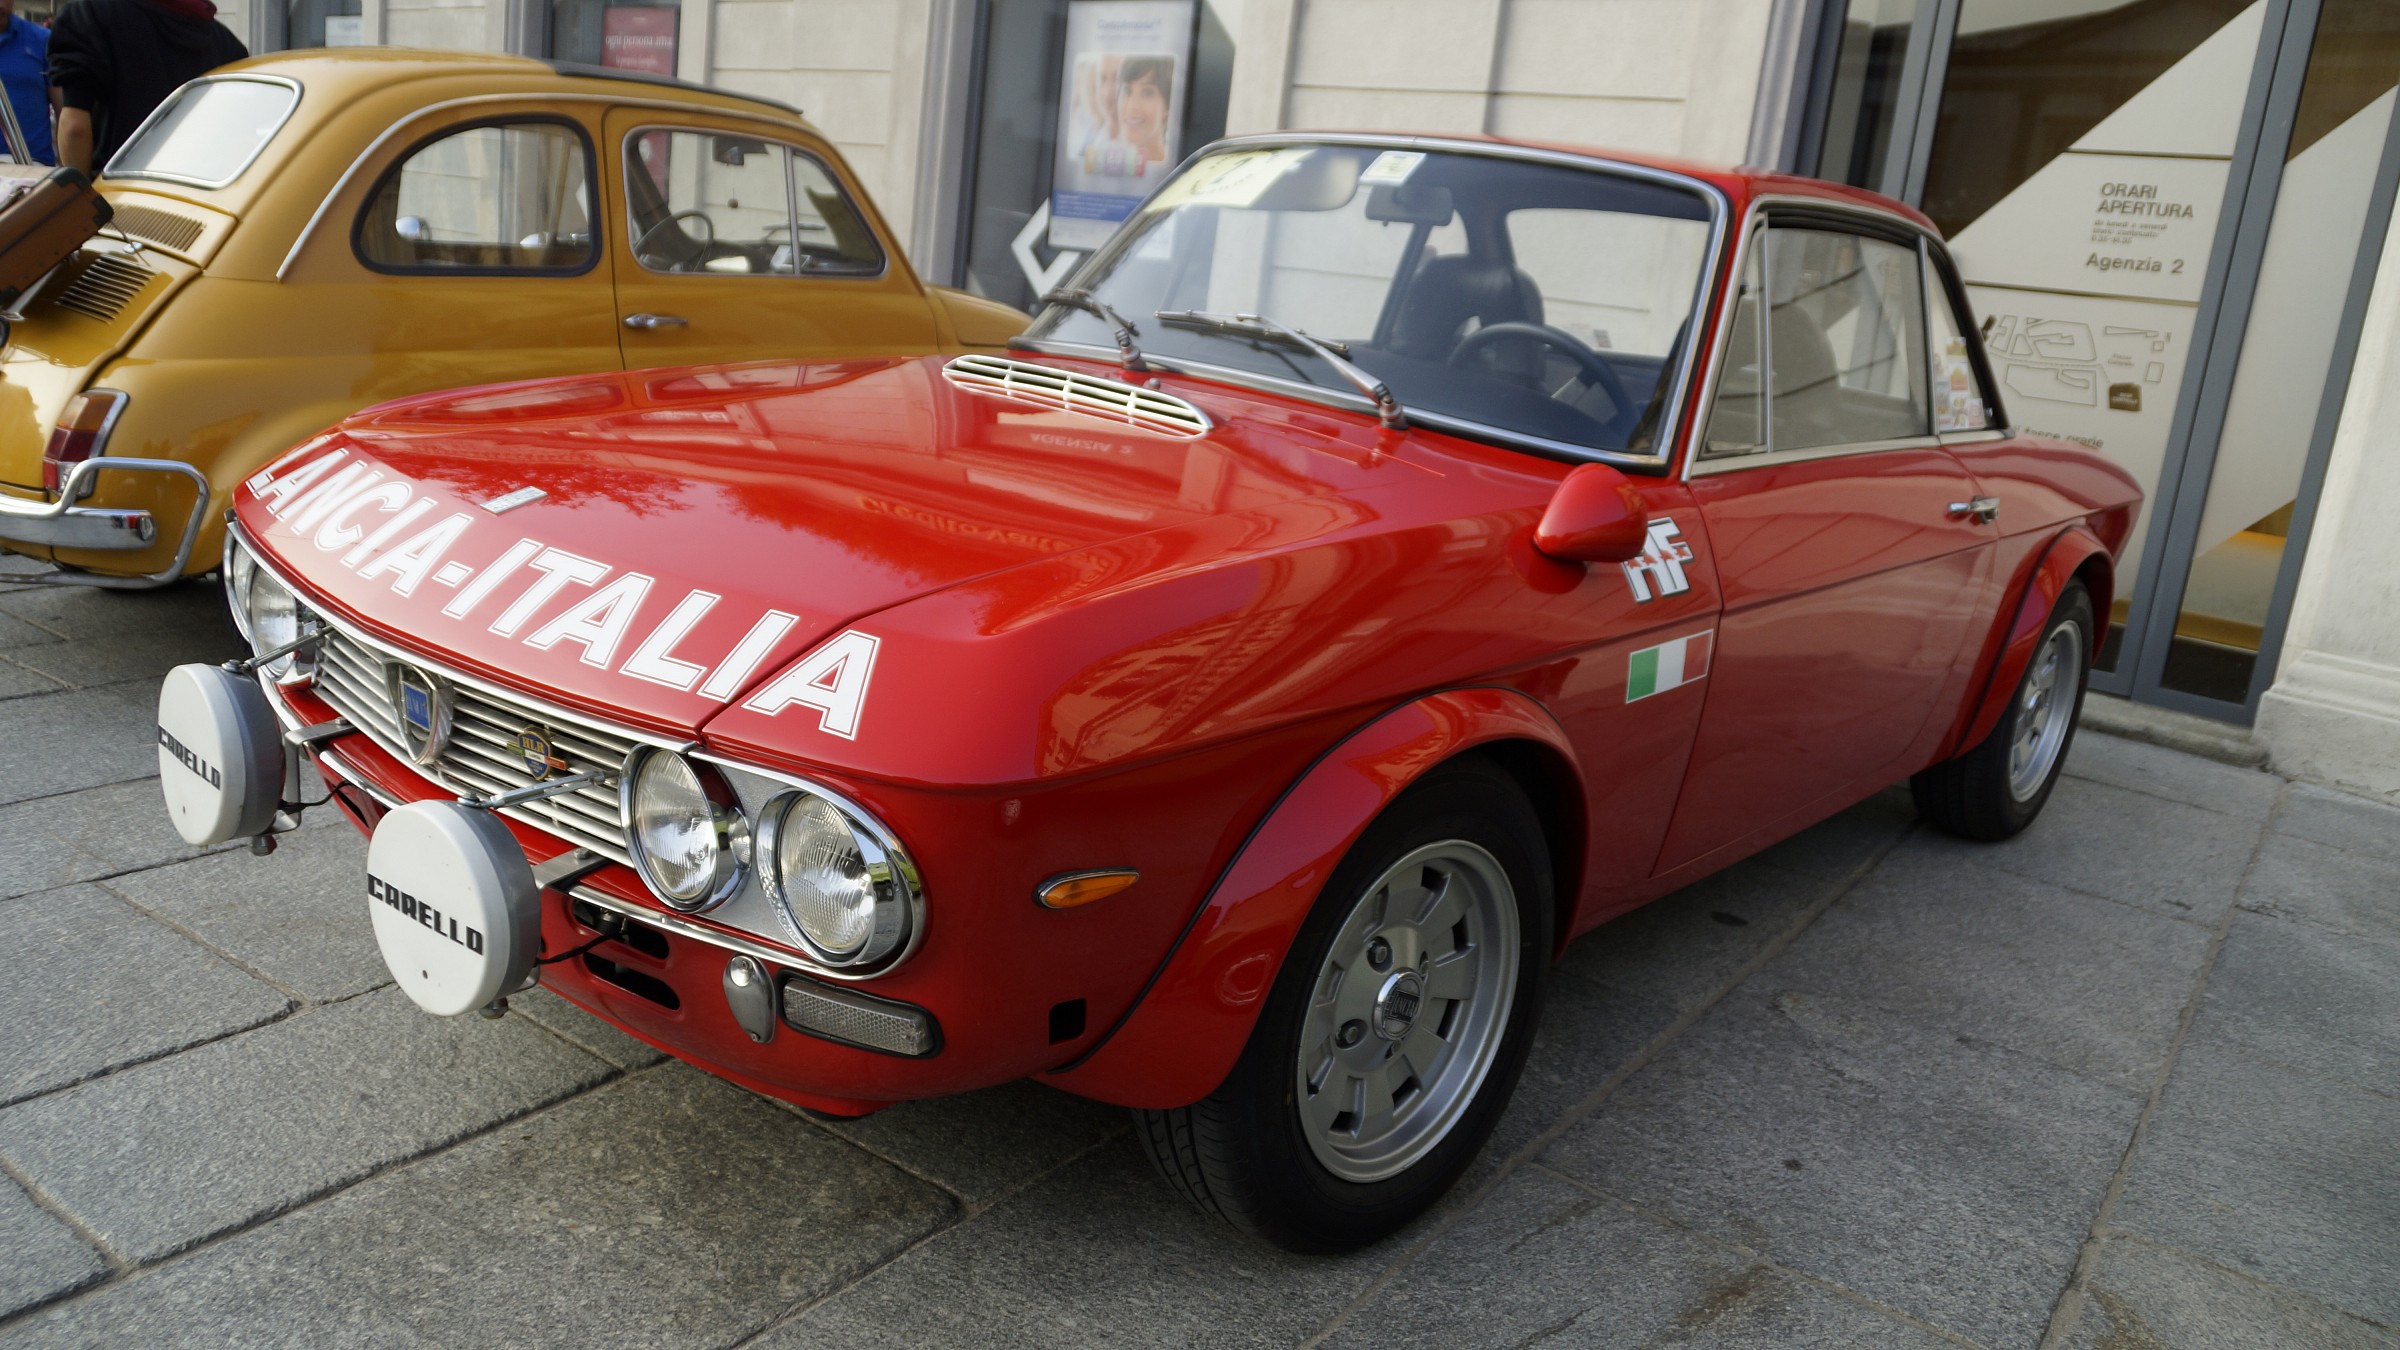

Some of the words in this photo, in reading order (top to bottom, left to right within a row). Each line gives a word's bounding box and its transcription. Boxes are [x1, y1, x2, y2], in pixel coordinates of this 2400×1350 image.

[2101, 182, 2158, 199] ORARI
[2097, 199, 2194, 219] APERTURA
[2086, 252, 2163, 272] Agenzia
[2170, 258, 2186, 275] 2
[522, 736, 545, 754] HLR
[158, 724, 221, 791] CARELLO
[367, 872, 484, 956] CARELLO
